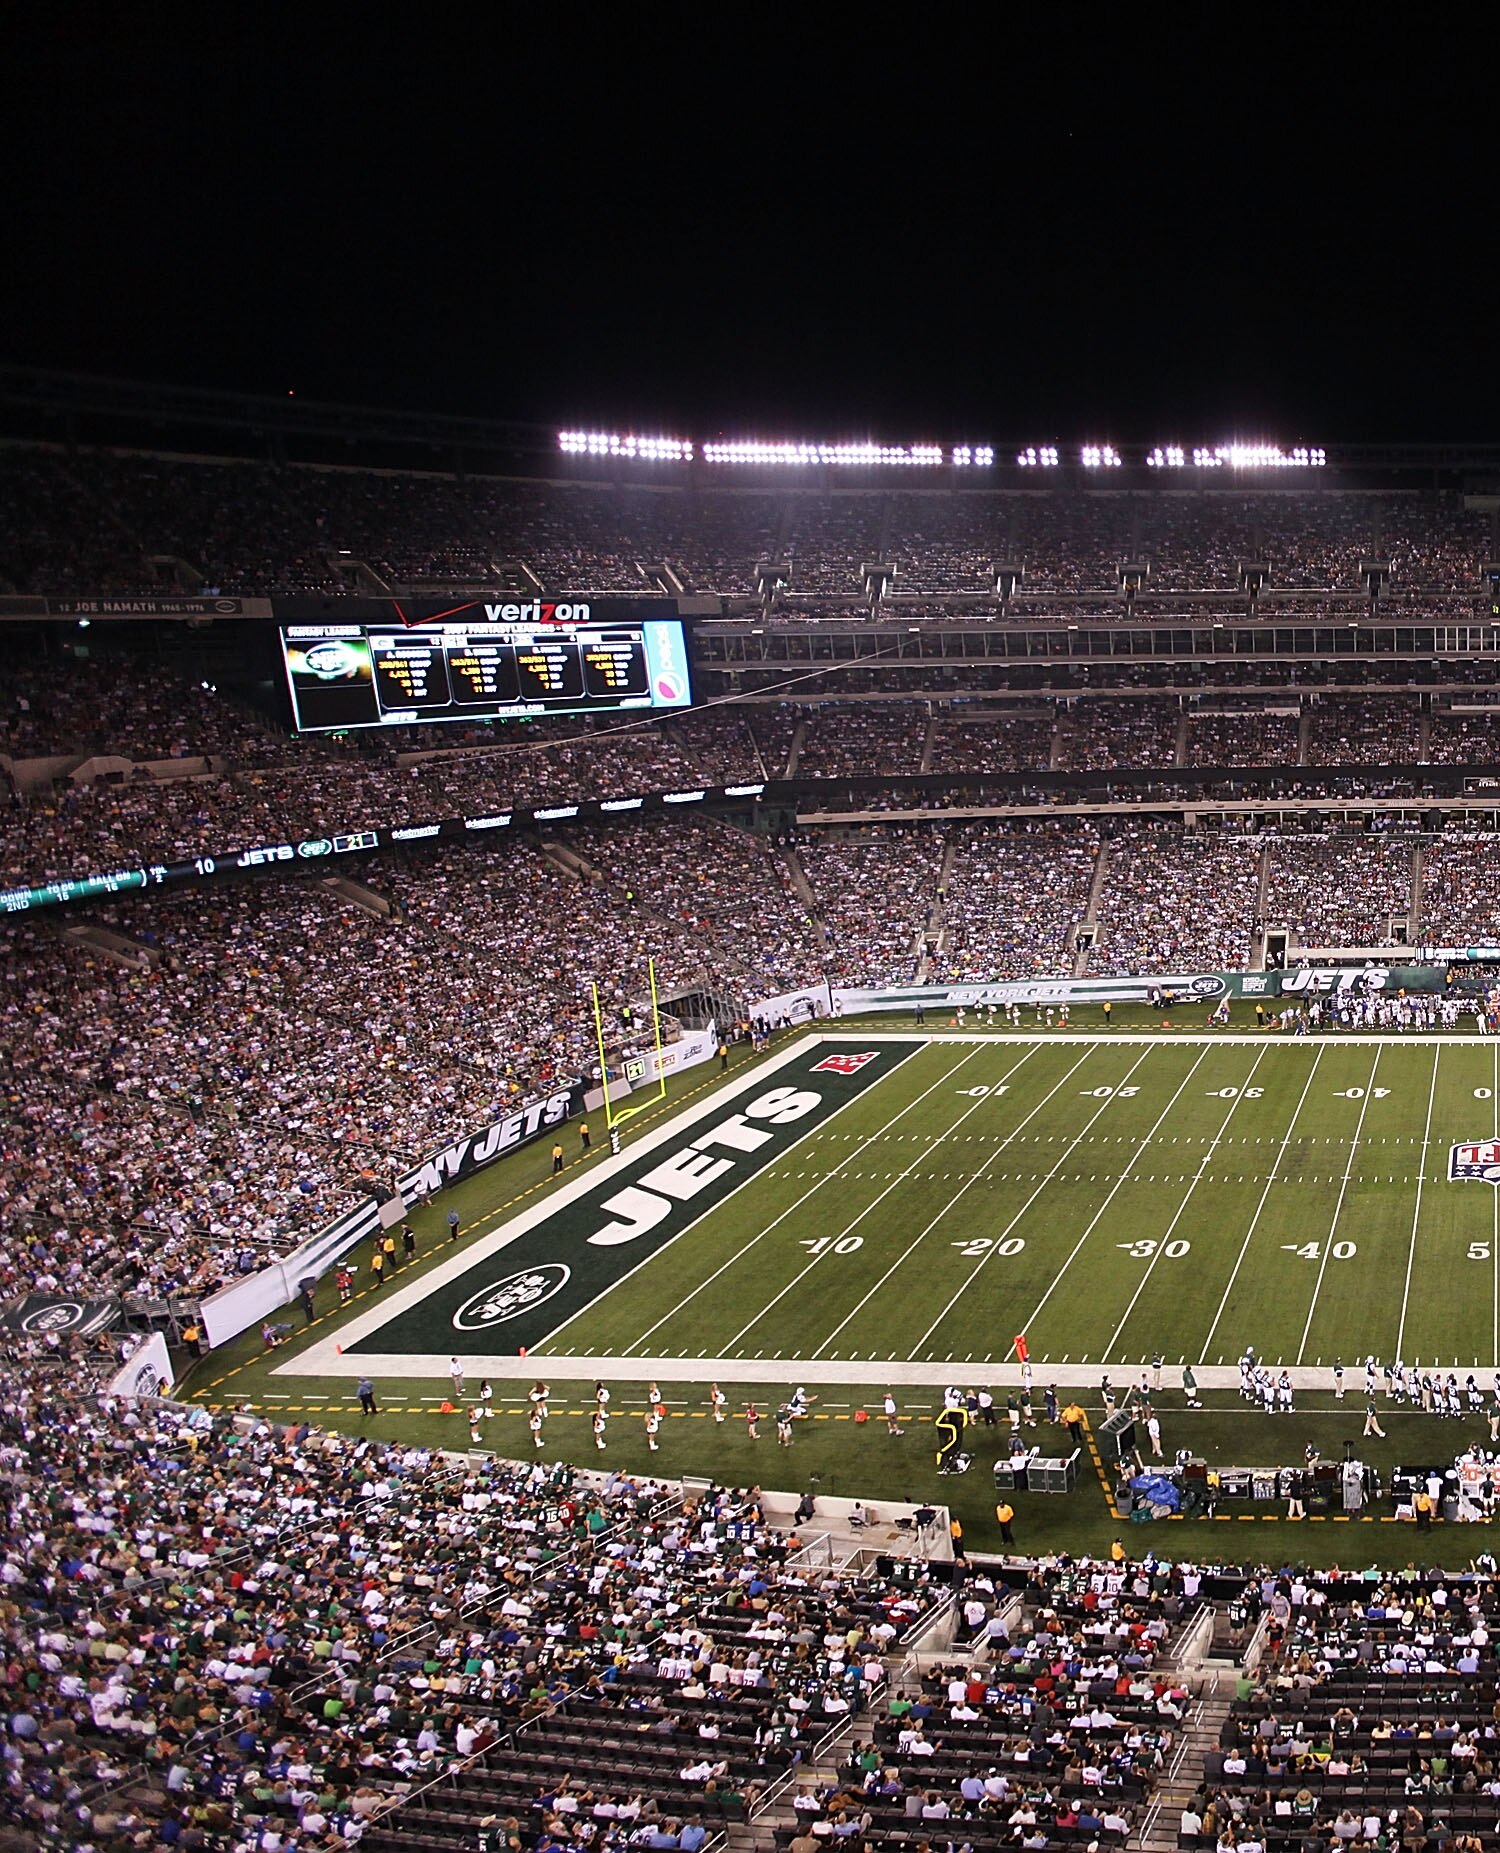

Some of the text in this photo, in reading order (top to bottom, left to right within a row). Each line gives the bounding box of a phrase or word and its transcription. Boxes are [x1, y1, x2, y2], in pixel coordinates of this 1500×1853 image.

[75, 602, 98, 612] JOE
[103, 602, 157, 613] NAMATH
[484, 599, 590, 624] verizon
[655, 625, 675, 671] pepsi
[346, 836, 363, 850] 21
[1477, 832, 1495, 841] OF
[236, 845, 294, 867] JETS
[195, 859, 215, 875] 10
[88, 871, 131, 887] BALL ON
[155, 874, 164, 883] 2
[104, 883, 119, 893] 16
[0, 890, 33, 903] DOWN
[56, 892, 70, 902] 15
[6, 900, 30, 912] 2ND
[1281, 968, 1390, 991] JETS
[946, 986, 1072, 1000] NEW YORK JETS
[629, 1062, 643, 1078] 21
[971, 1085, 1010, 1096] 10
[1095, 1085, 1140, 1097] 20
[1220, 1086, 1265, 1098] 30
[1345, 1087, 1391, 1098] 40
[419, 1091, 572, 1191] NY JETS
[586, 1087, 822, 1246] JETS
[806, 1236, 864, 1255] 10
[959, 1237, 1025, 1257] 20
[1130, 1239, 1190, 1259] 30
[1295, 1241, 1358, 1260] 40
[546, 1511, 557, 1522] 16
